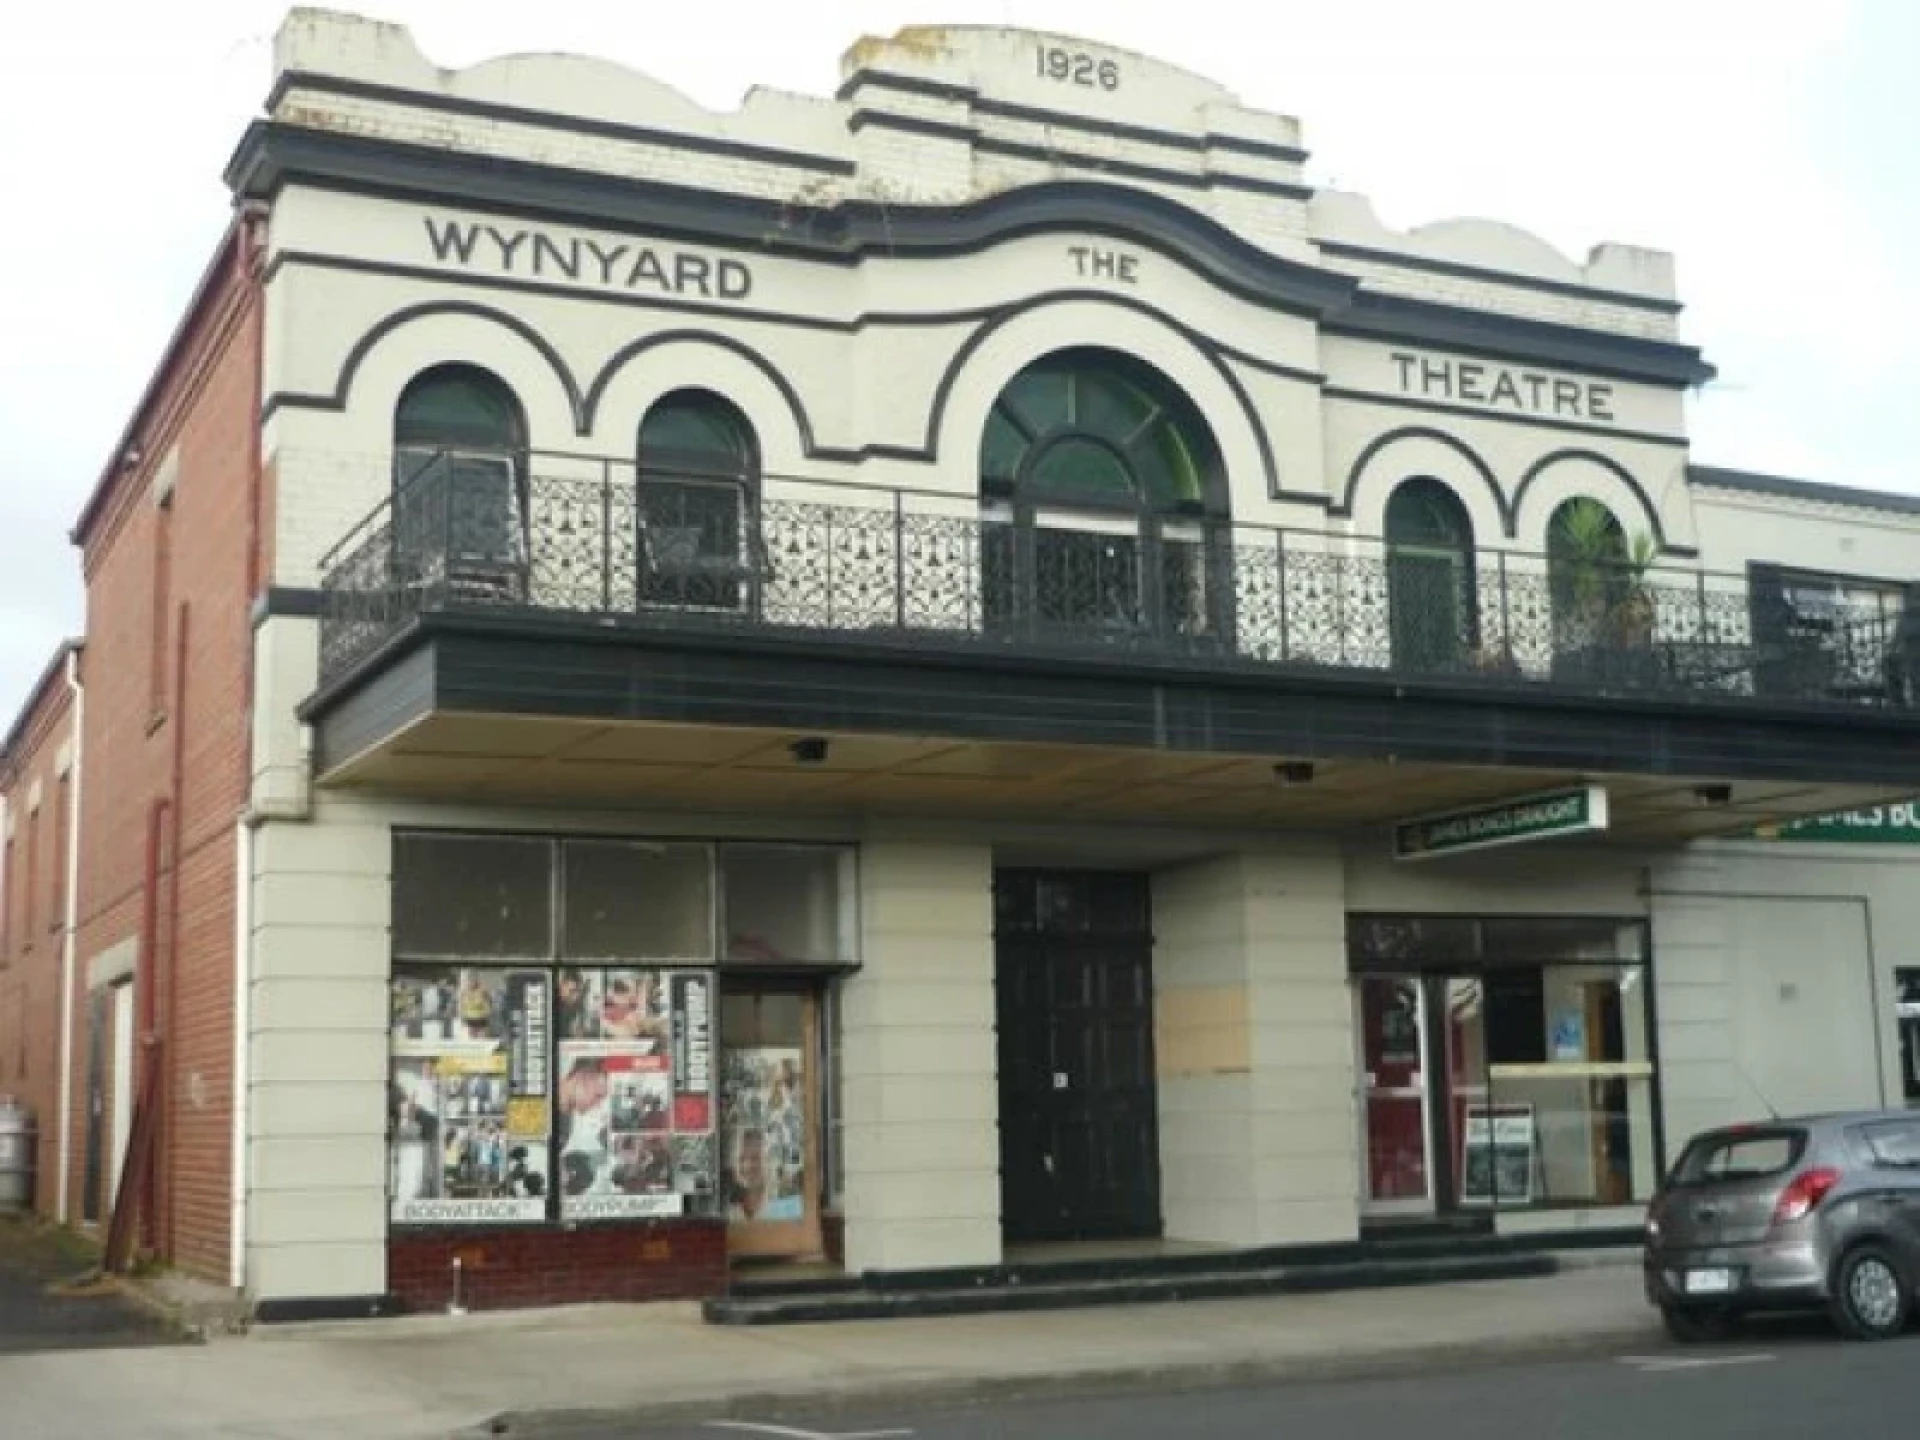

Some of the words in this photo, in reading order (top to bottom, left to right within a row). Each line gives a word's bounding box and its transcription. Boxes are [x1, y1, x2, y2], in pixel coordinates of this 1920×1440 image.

[1036, 46, 1119, 91] 1926
[424, 217, 752, 299] WYNYARD
[1067, 246, 1138, 284] THE
[1391, 351, 1615, 421] THEATRE
